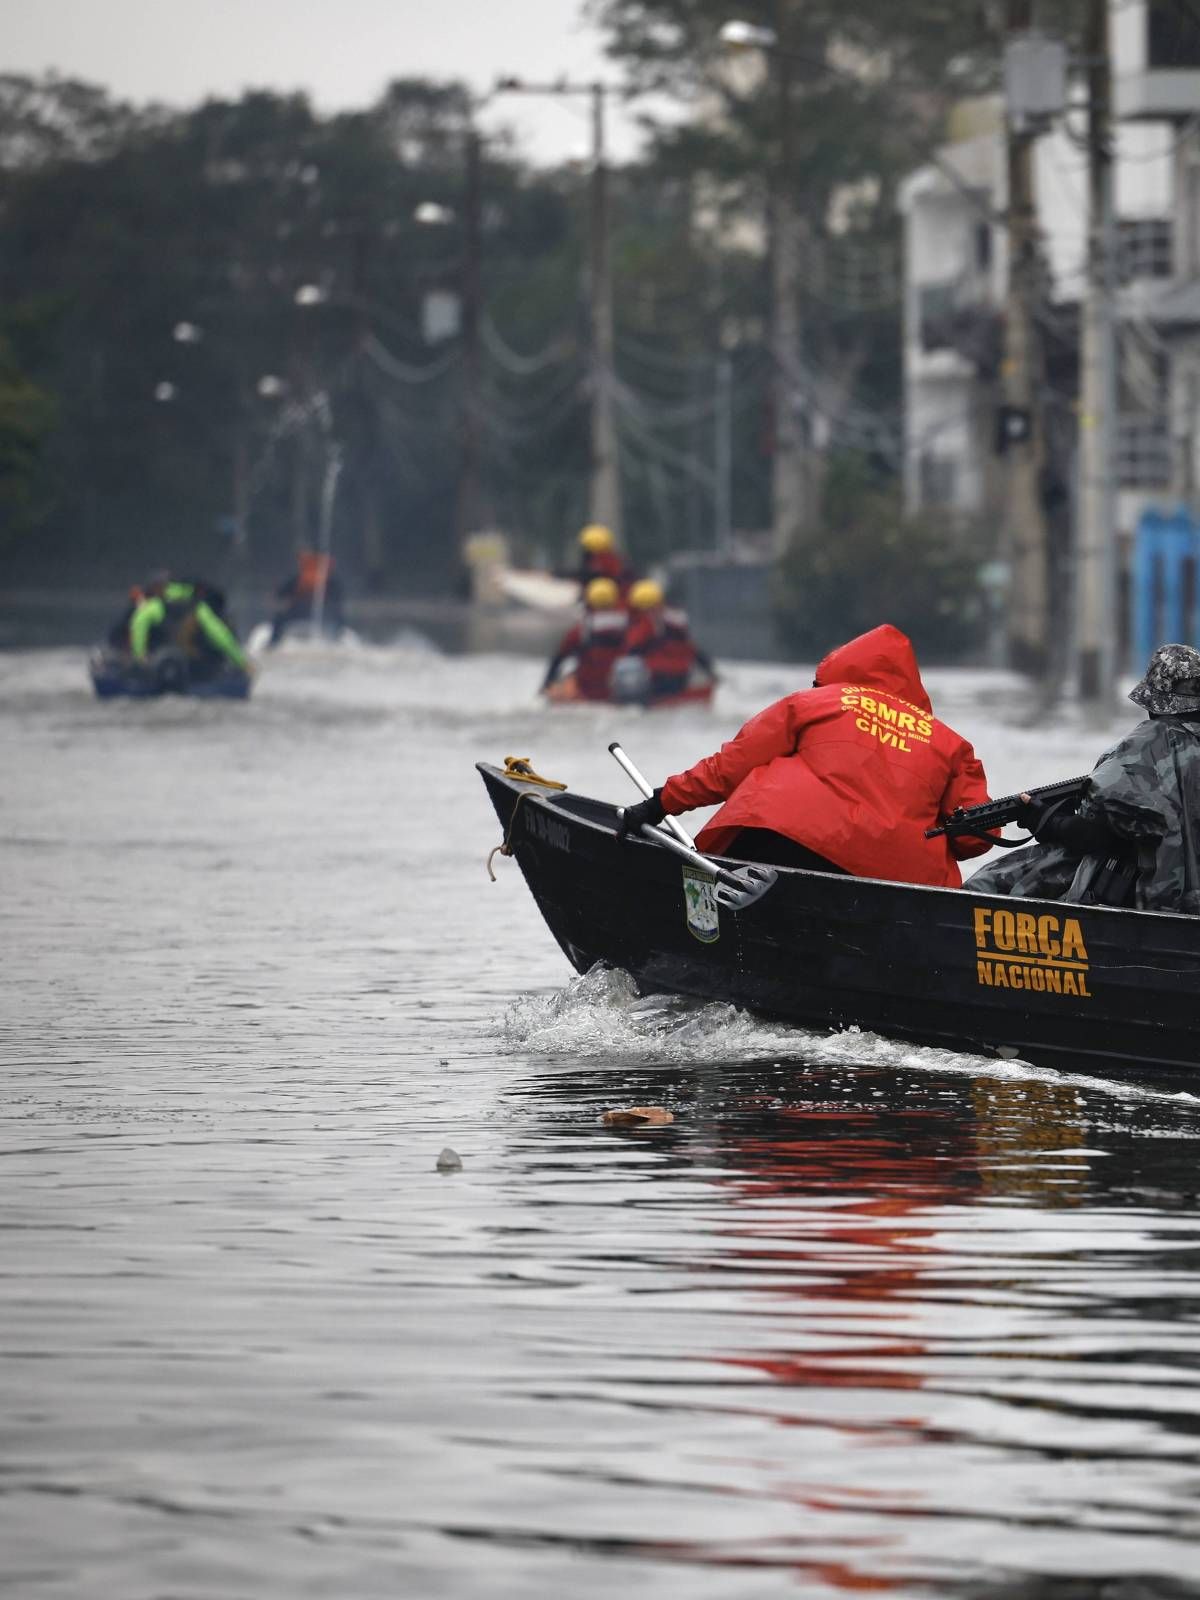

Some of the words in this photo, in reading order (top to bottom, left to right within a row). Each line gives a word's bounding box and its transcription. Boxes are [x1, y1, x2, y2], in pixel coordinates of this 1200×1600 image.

[841, 695, 933, 737] CBMRS
[855, 717, 912, 753] CIVIL
[974, 907, 1089, 960] FORÇA
[977, 960, 1092, 997] NACIONAL
